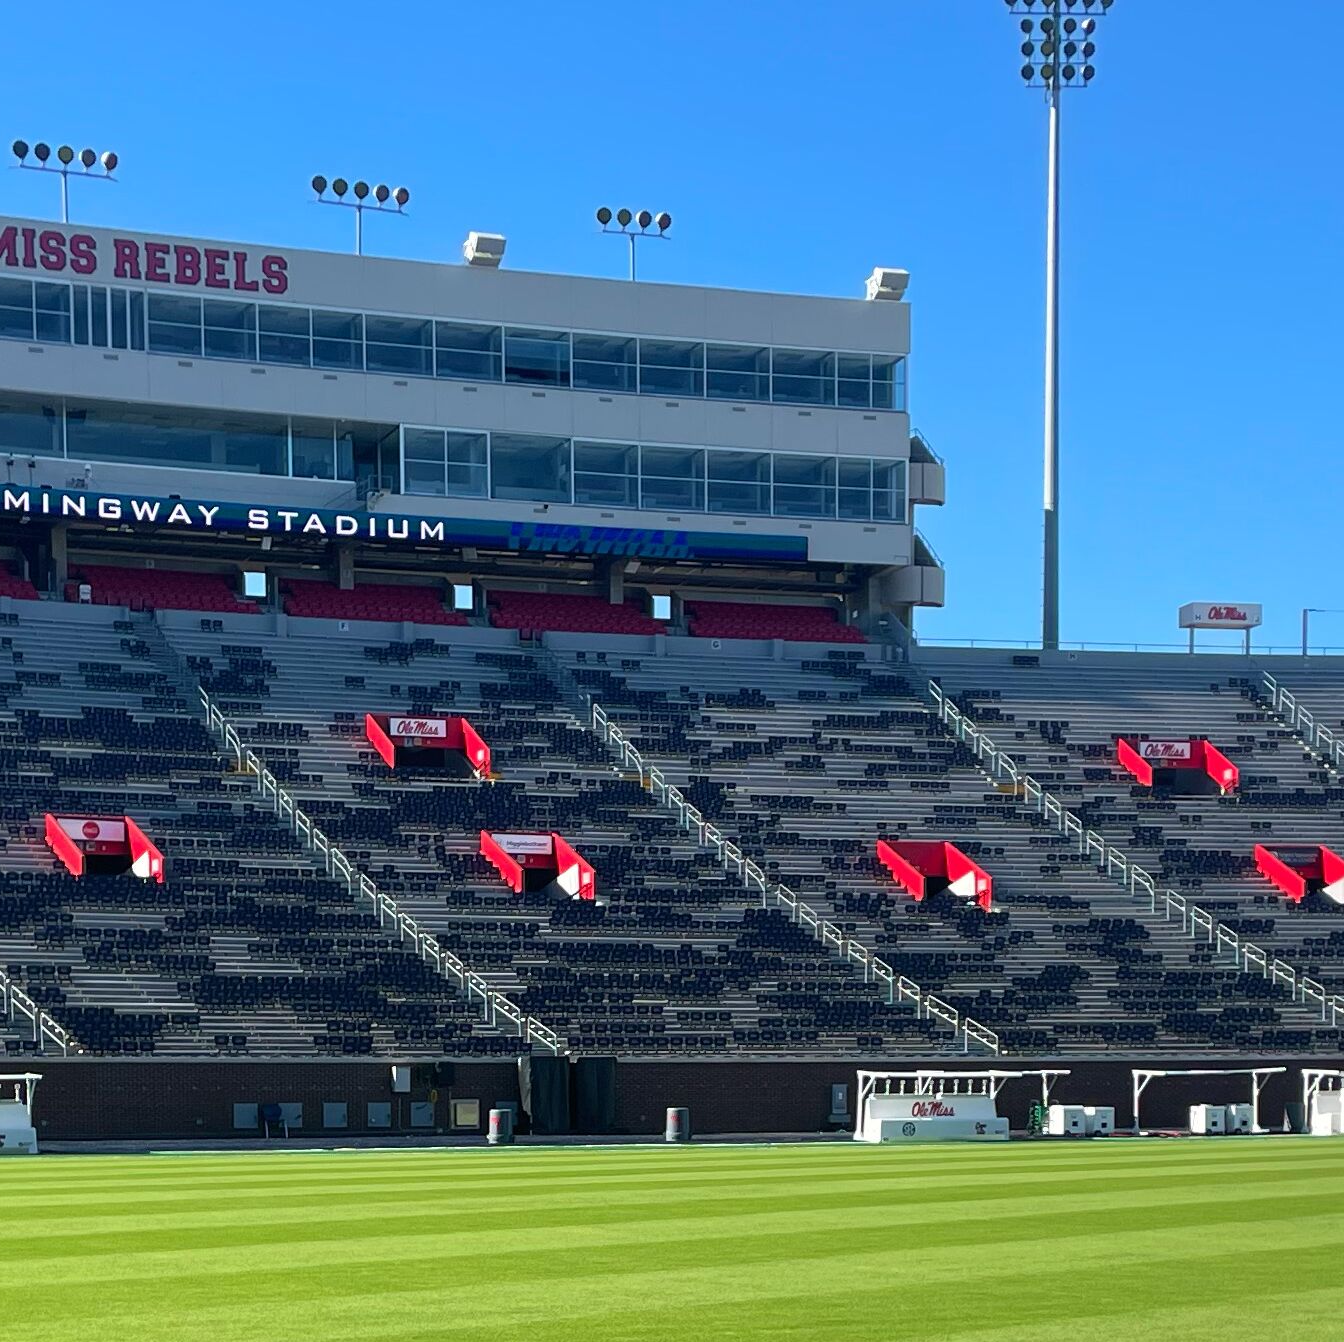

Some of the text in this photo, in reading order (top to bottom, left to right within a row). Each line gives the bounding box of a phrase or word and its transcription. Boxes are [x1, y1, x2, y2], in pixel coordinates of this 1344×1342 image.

[113, 238, 289, 294] REBELS
[247, 508, 445, 542] STADIUM
[1208, 606, 1247, 621] Ole Miss
[397, 720, 439, 735] Ole Miss
[1144, 743, 1185, 757] Ole Miss
[911, 1101, 955, 1117] Ole Miss
